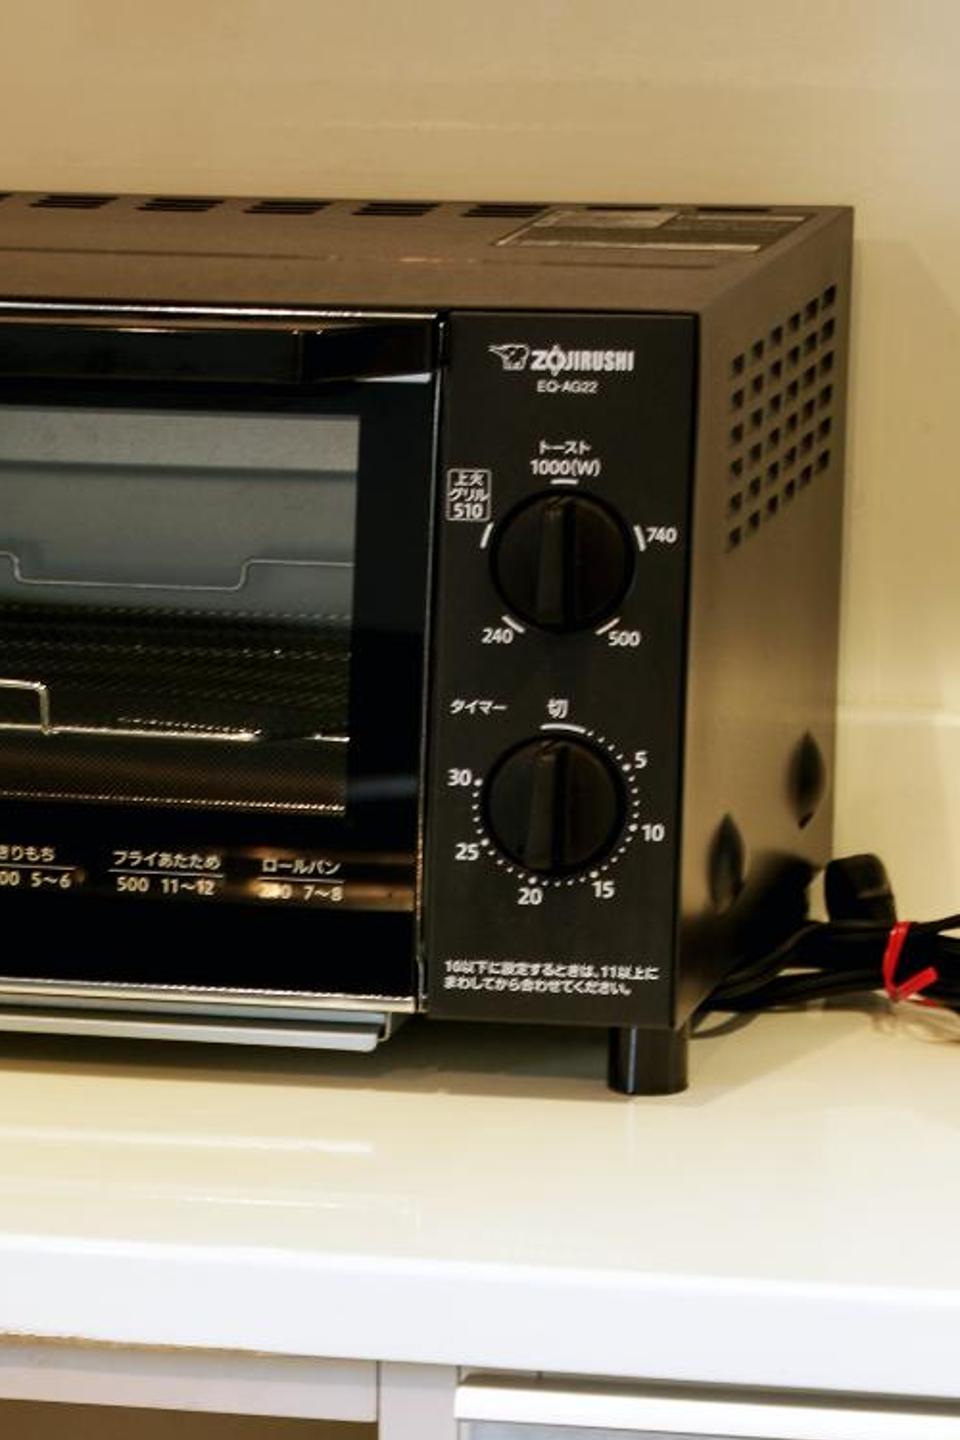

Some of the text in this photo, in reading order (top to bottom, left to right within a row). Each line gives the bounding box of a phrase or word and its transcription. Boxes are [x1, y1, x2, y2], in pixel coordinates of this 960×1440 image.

[530, 346, 635, 375] ZOJIRUSHI
[539, 441, 591, 455] トースト
[530, 459, 601, 477] 1000(W)
[448, 488, 490, 502] グリル
[453, 504, 483, 519] 510
[646, 528, 677, 543] 740
[482, 629, 513, 644] 240
[608, 631, 640, 646] 500
[449, 700, 507, 715] タイマー
[548, 699, 568, 718] 切
[634, 751, 647, 769] 5
[448, 769, 471, 786] 30
[642, 825, 664, 842] 10
[112, 851, 221, 871] フライあたため
[455, 844, 479, 861] 25
[117, 876, 149, 893] 500
[592, 882, 615, 899] 15
[517, 888, 542, 905] 20
